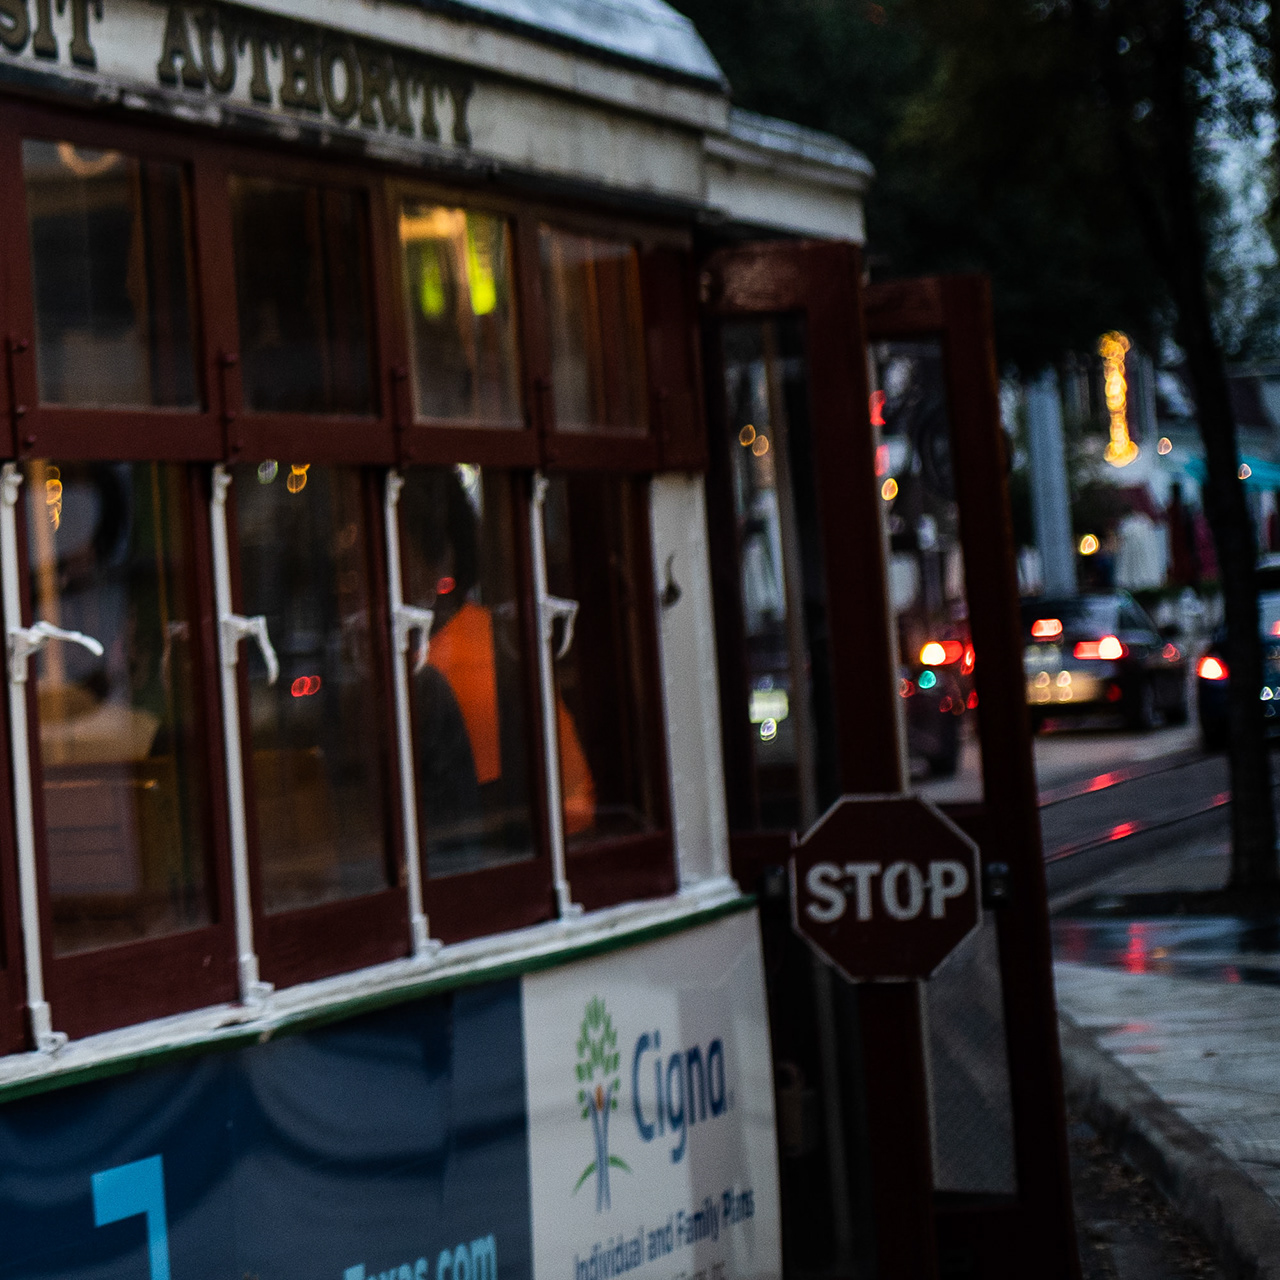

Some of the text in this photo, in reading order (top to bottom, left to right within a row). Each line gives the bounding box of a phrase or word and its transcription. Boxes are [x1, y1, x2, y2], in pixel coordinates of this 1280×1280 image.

[158, 0, 474, 148] AUTHORITY
[806, 861, 969, 923] STOP
[632, 1029, 727, 1164] Cigna
[575, 1226, 645, 1280] Individual
[648, 1213, 674, 1262] and
[676, 1196, 720, 1250] Family
